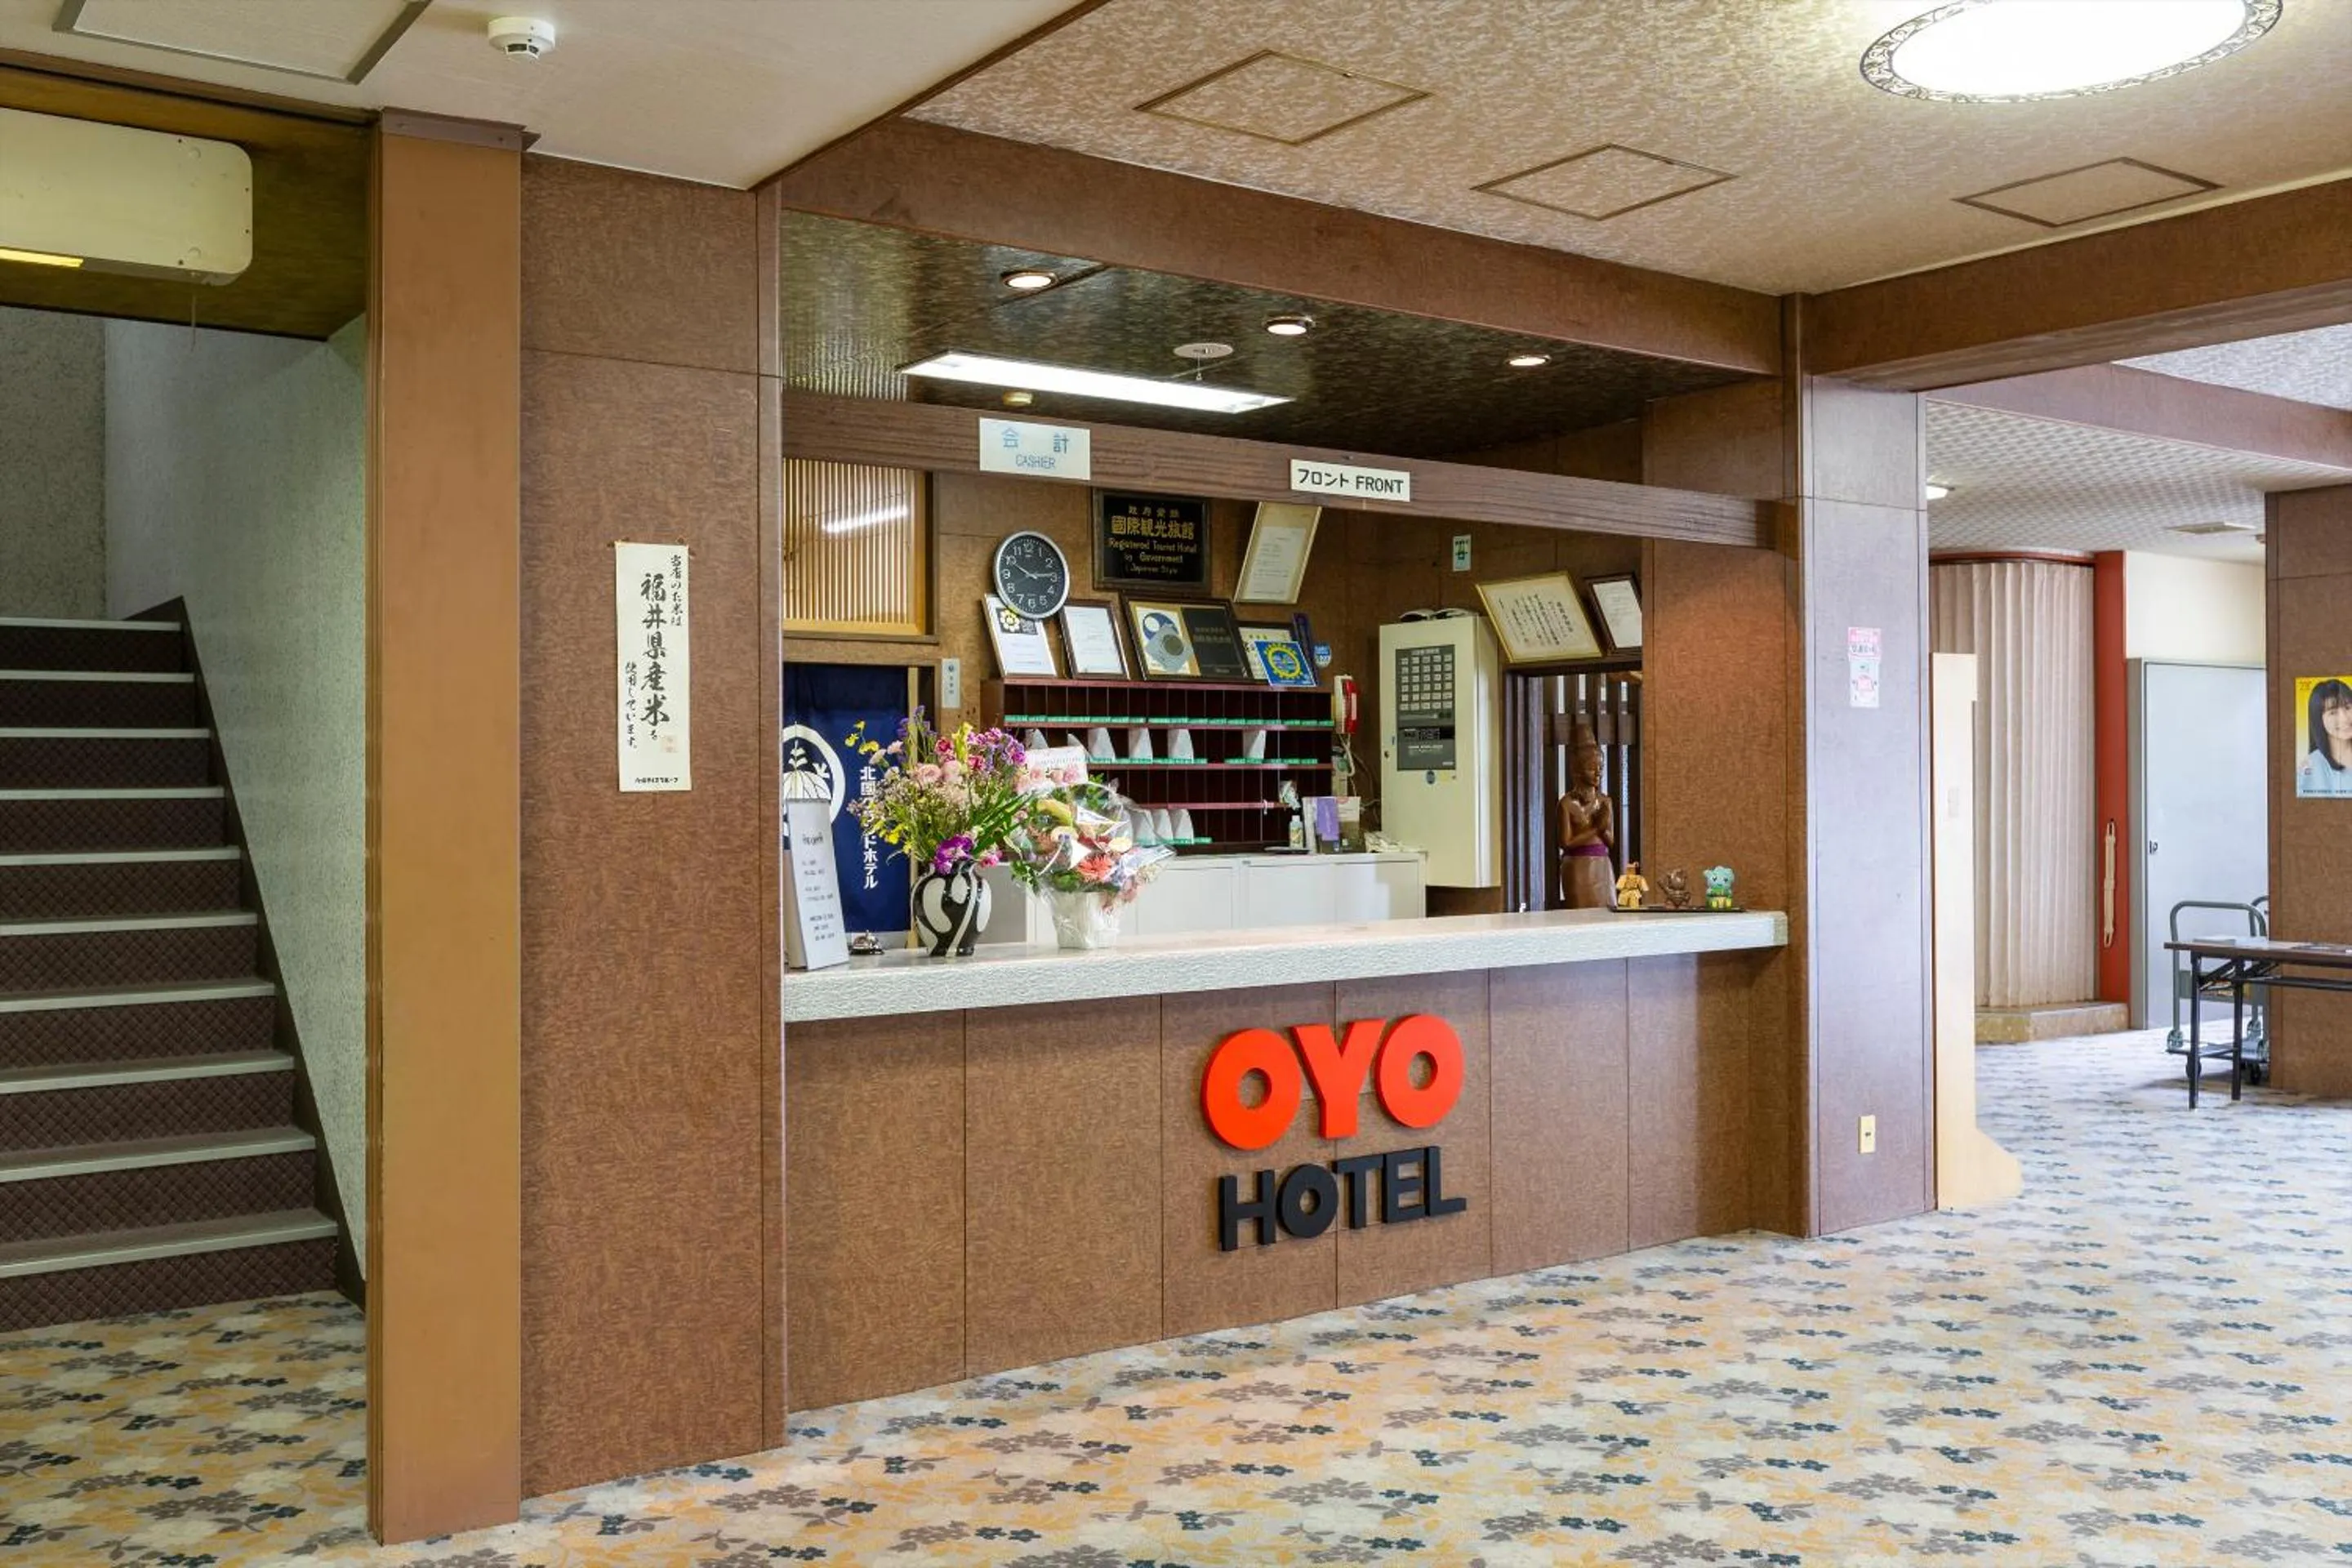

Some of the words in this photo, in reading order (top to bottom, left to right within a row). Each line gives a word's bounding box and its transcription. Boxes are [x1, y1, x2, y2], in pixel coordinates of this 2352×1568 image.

[1001, 427, 1070, 454] 会計
[1015, 453, 1056, 470] CASHIER
[1297, 468, 1349, 488] フロント
[1356, 474, 1404, 494] FRONT
[1013, 546, 1022, 556] 11
[1038, 546, 1042, 557] 1
[1045, 558, 1053, 568] 2
[1139, 551, 1183, 564] Government
[1002, 568, 1011, 579] 9
[1050, 572, 1058, 582] 3
[1007, 582, 1015, 593] 8
[1047, 585, 1054, 595] 4
[1017, 593, 1025, 604] 7
[1027, 598, 1036, 608] 6
[1039, 595, 1047, 605] 5
[1200, 1013, 1467, 1151] OYO
[1218, 1145, 1467, 1252] HOTEL
